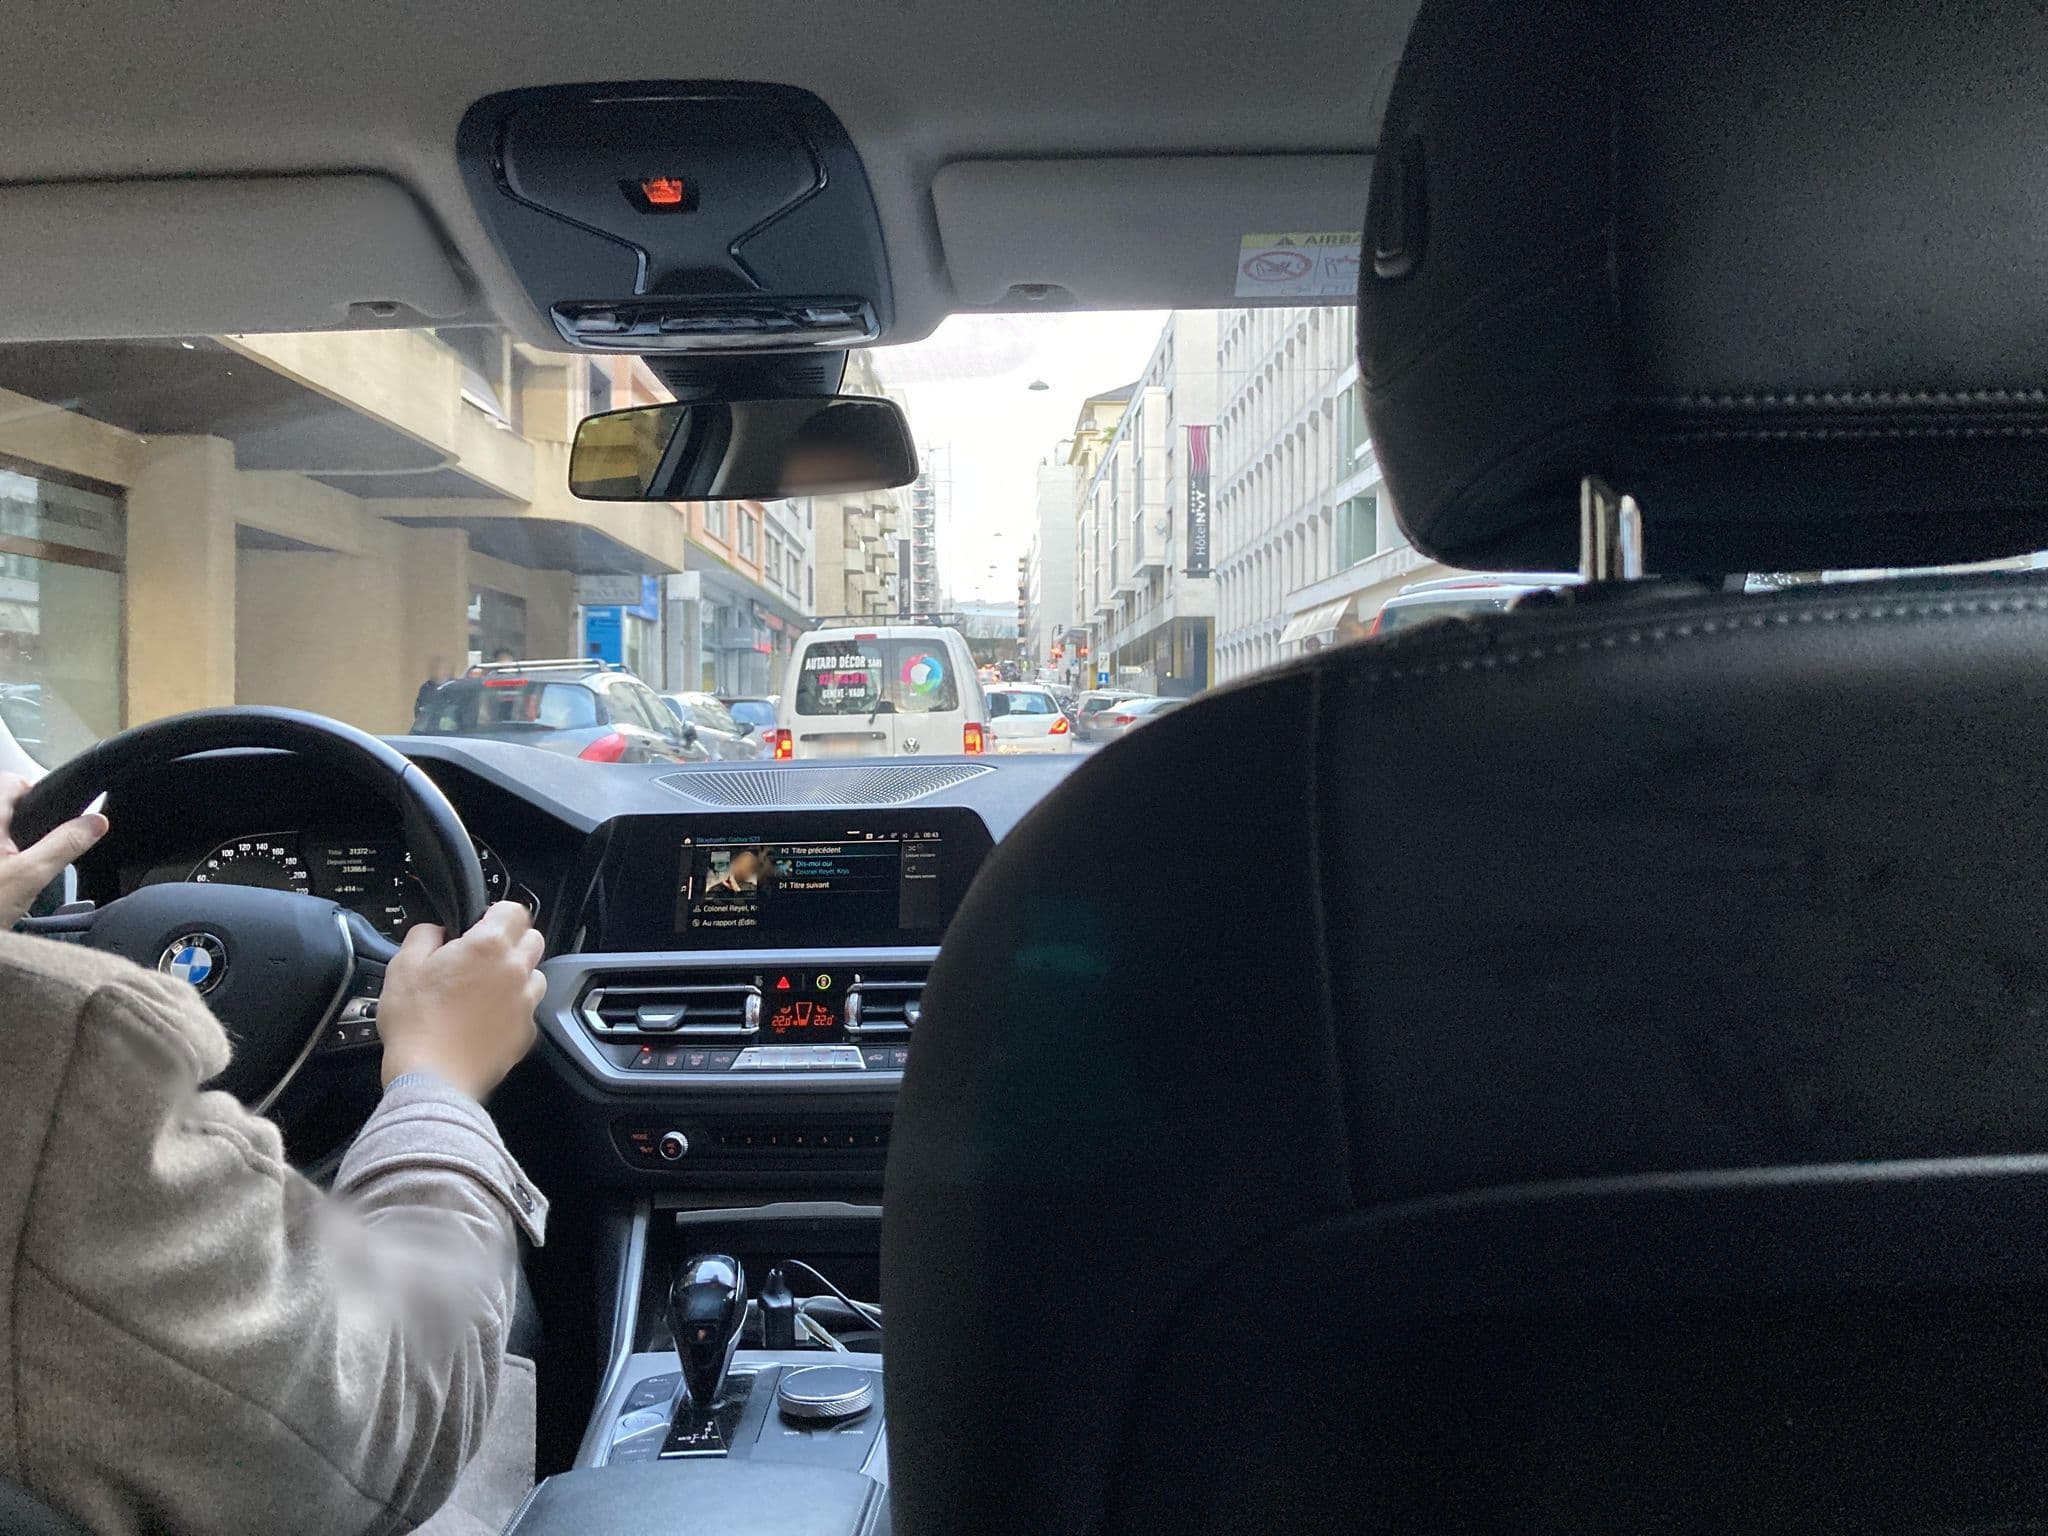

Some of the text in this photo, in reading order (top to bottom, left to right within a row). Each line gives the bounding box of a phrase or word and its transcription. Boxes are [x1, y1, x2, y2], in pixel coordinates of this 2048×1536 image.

[805, 656, 837, 670] AUTARD
[839, 654, 866, 668] DÉCOR
[808, 846, 842, 855] précédent
[405, 852, 411, 861] 2
[393, 877, 398, 886] 1
[492, 875, 499, 883] 6
[713, 919, 737, 927] rapport
